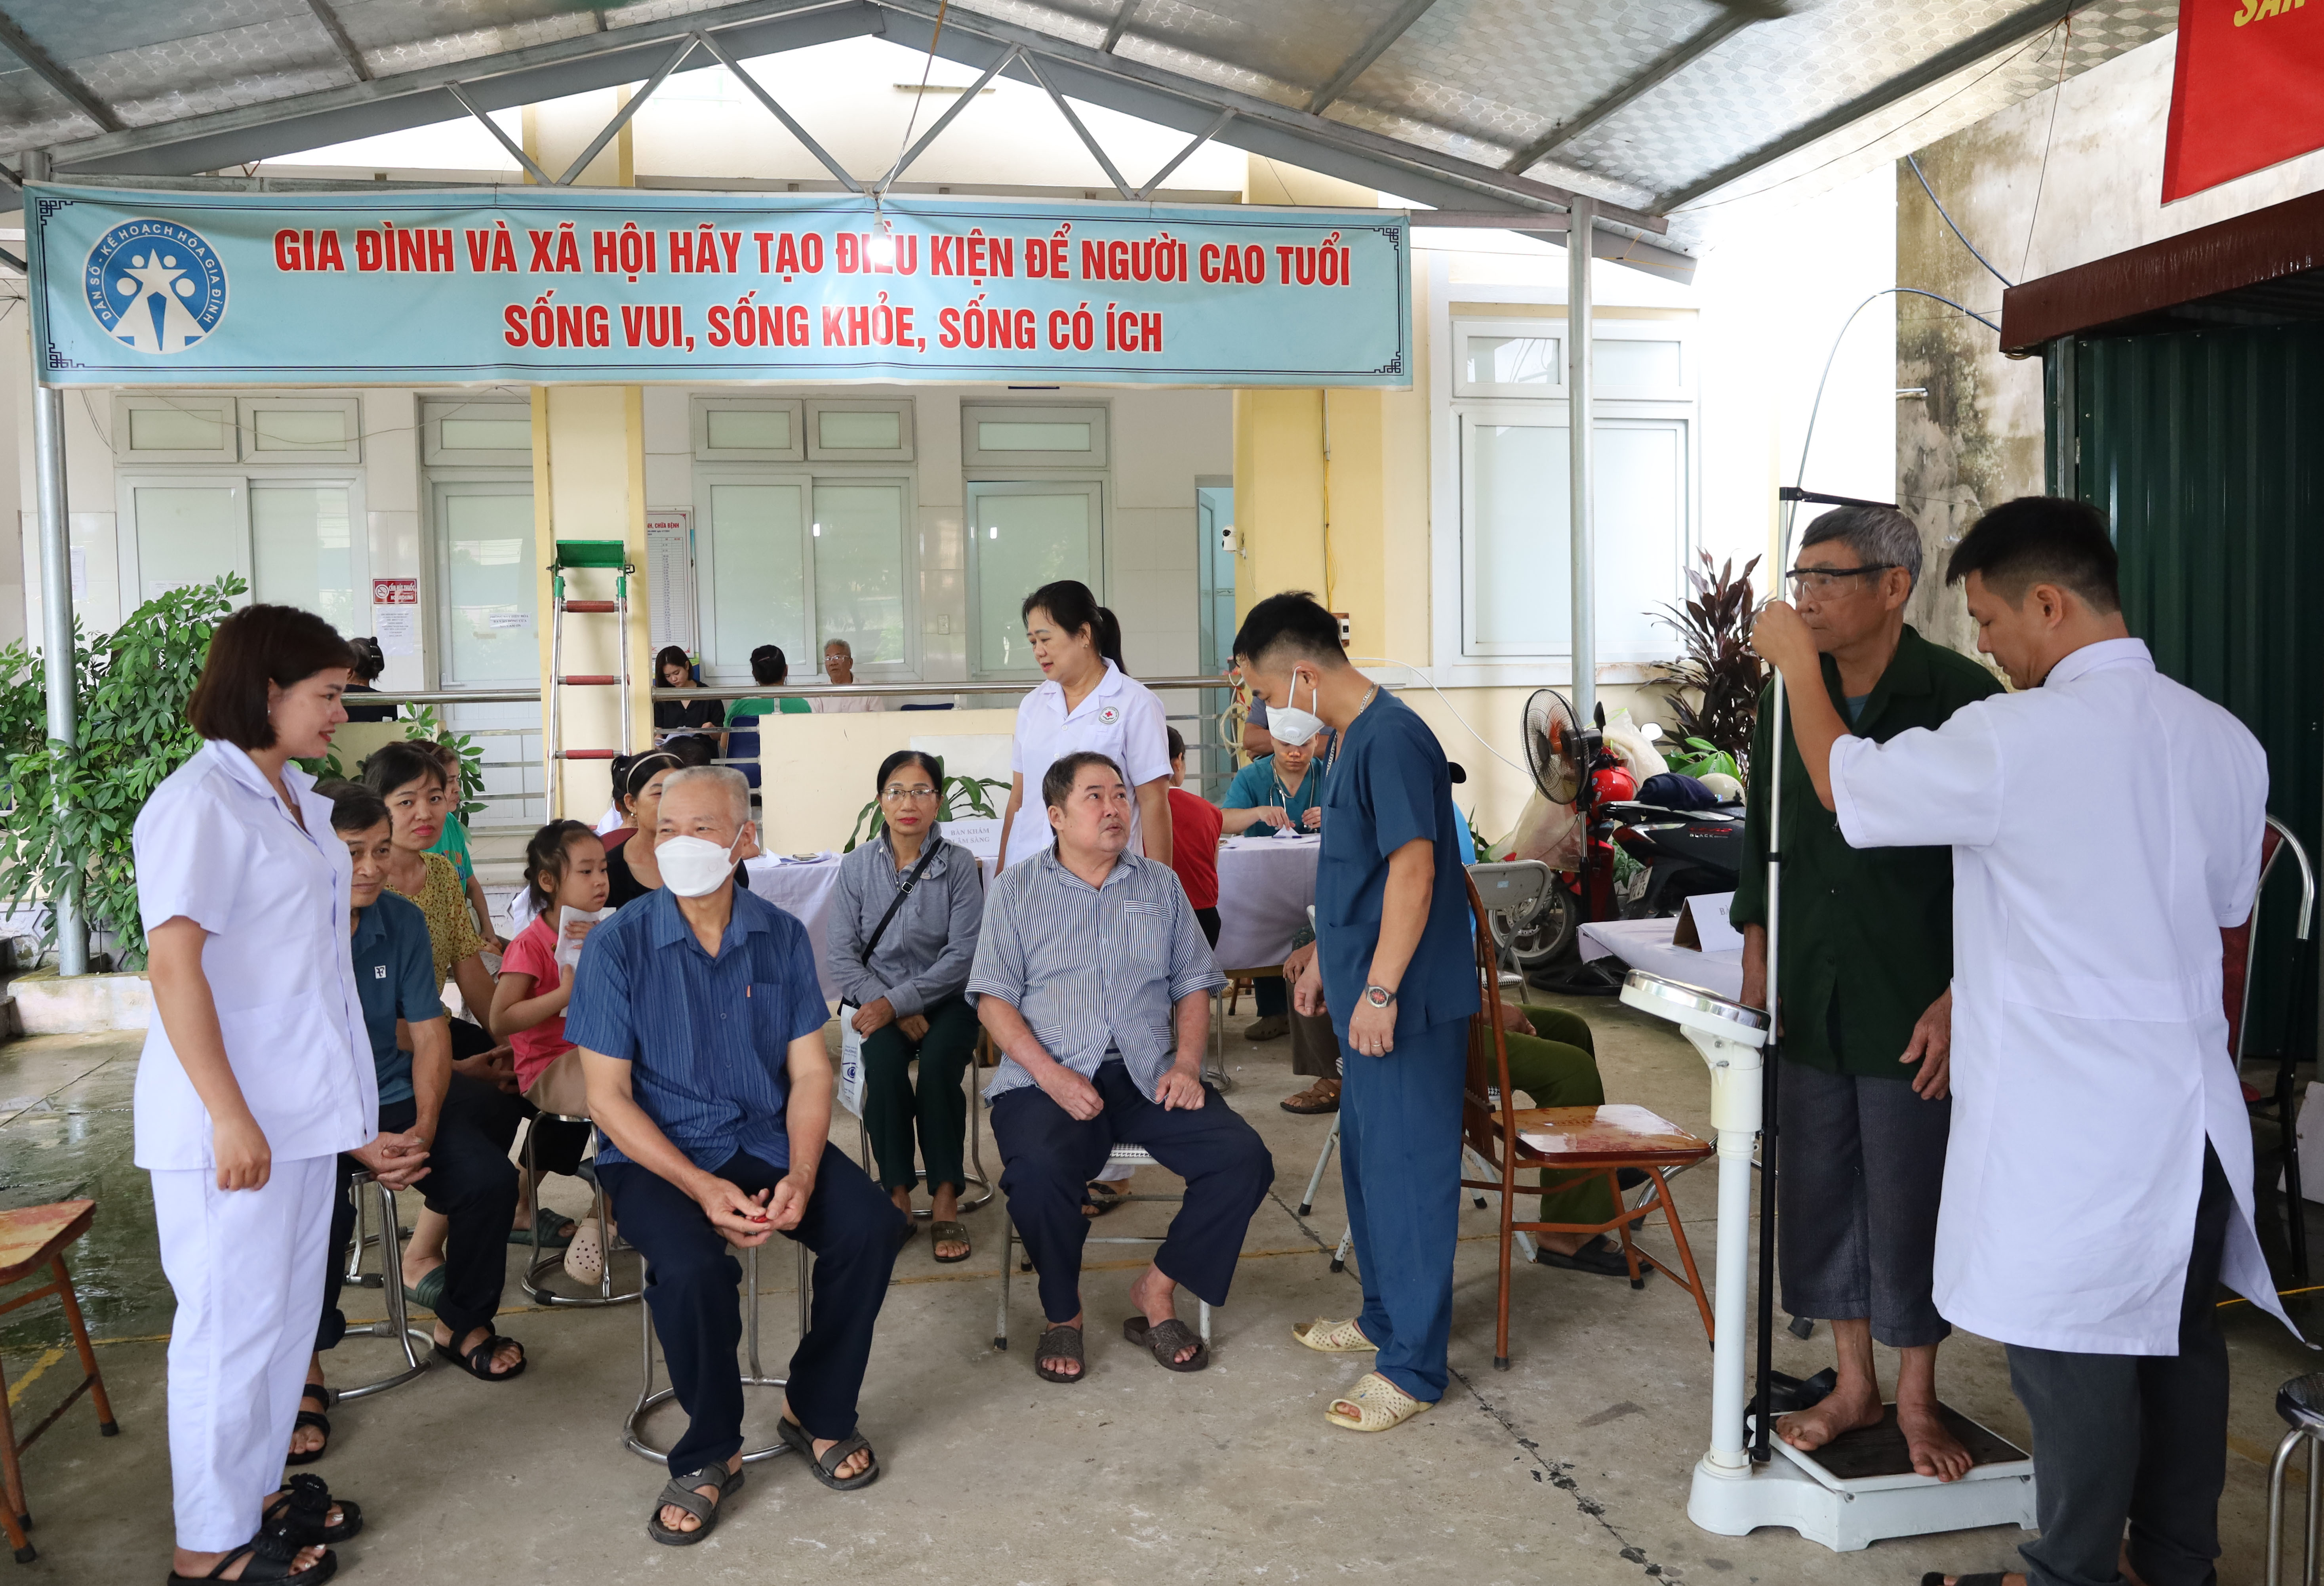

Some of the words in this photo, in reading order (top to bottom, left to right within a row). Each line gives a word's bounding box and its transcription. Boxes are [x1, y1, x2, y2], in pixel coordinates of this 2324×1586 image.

[101, 234, 118, 256] KẾ
[118, 224, 173, 240] HOẠCH
[177, 231, 206, 257] HÓA
[275, 229, 345, 271] GIA
[355, 221, 454, 272] ĐÌNH
[465, 220, 517, 272] VÀ
[528, 222, 582, 273] XÃ
[593, 222, 656, 283] HỘI
[669, 223, 742, 273] HÃY
[754, 232, 824, 283] TẠO
[931, 228, 1013, 286] KIỆN
[1025, 223, 1071, 279] ĐỂ
[1082, 232, 1188, 282] NGƯỜI
[1200, 243, 1265, 284] CAO
[1276, 231, 1350, 286] TUỔI
[88, 265, 101, 286] SỐ
[205, 259, 220, 284] GIA
[91, 291, 112, 320] DÂN
[203, 288, 224, 323] ĐÌNH
[505, 290, 610, 348] SỐNG
[621, 305, 694, 353] VUI,
[708, 291, 810, 347] SỐNG
[823, 291, 926, 353] KHỎE,
[939, 293, 1036, 350] SỐNG
[1049, 302, 1093, 351] CÓ
[1106, 302, 1162, 352] ÍCH
